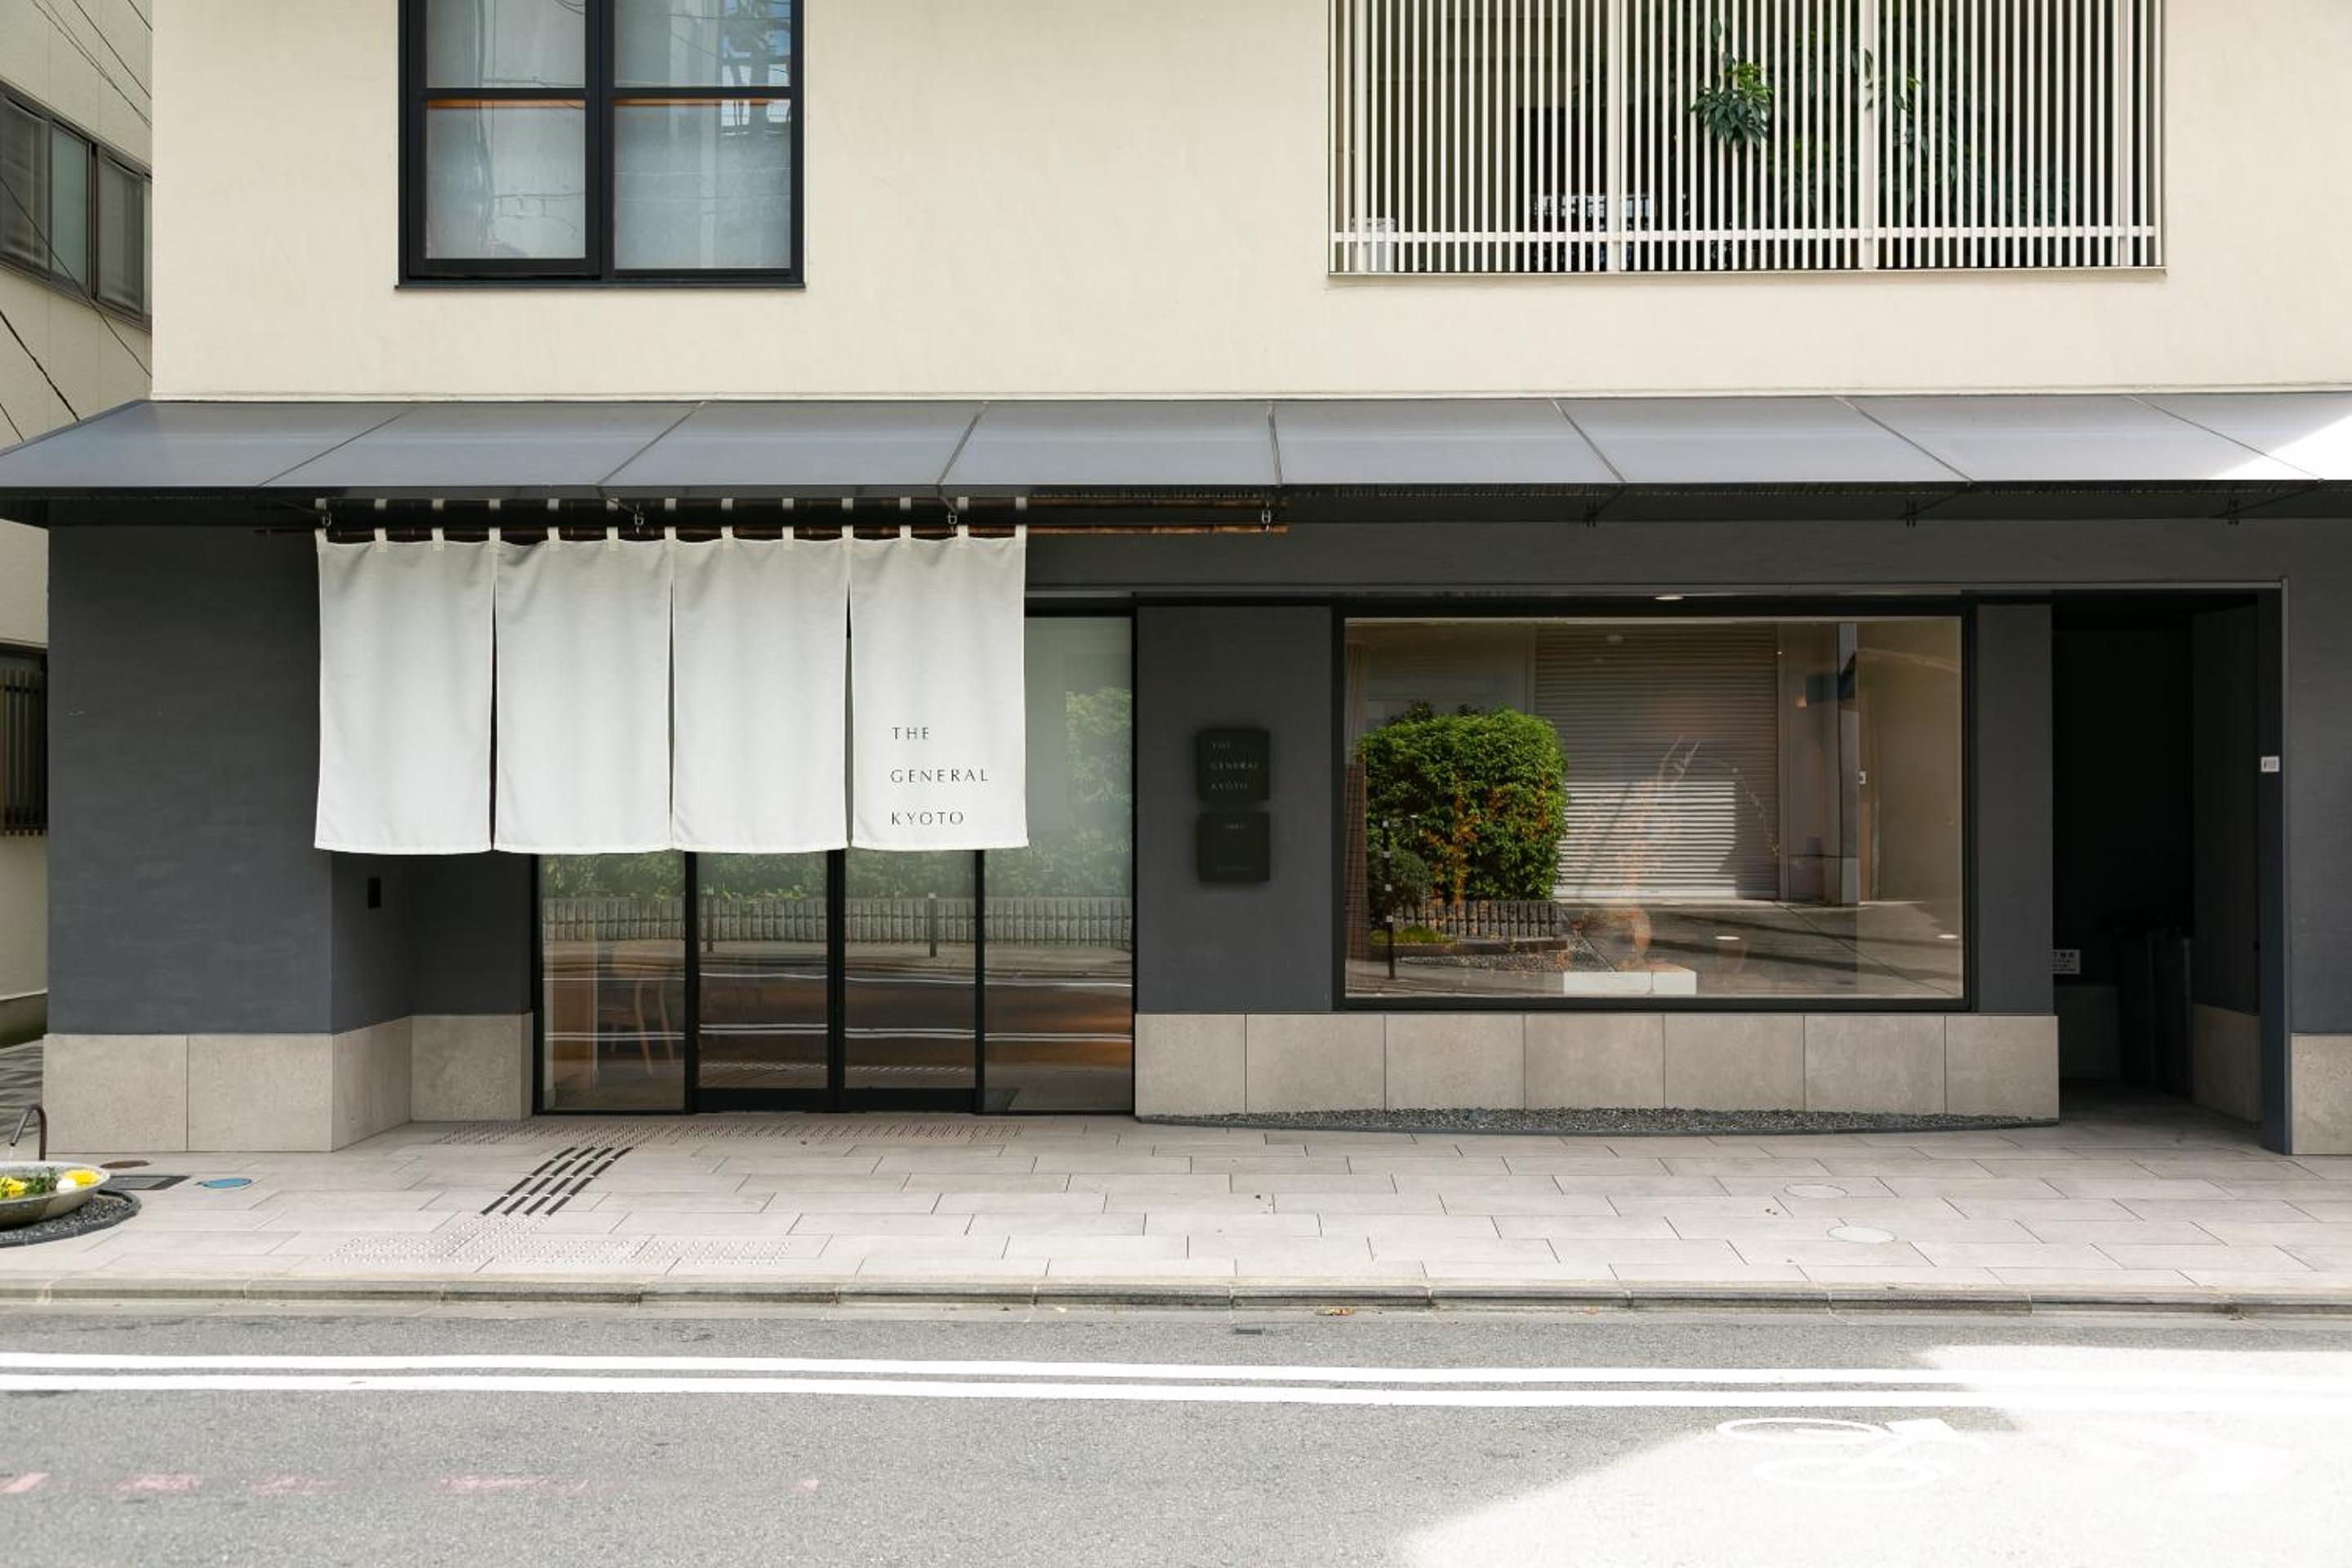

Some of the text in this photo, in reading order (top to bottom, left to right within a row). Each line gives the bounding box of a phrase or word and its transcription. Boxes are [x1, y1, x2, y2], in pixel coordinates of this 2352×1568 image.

[892, 727, 929, 740] THE
[890, 768, 989, 783] GENERAL
[891, 811, 964, 826] KYOTO
